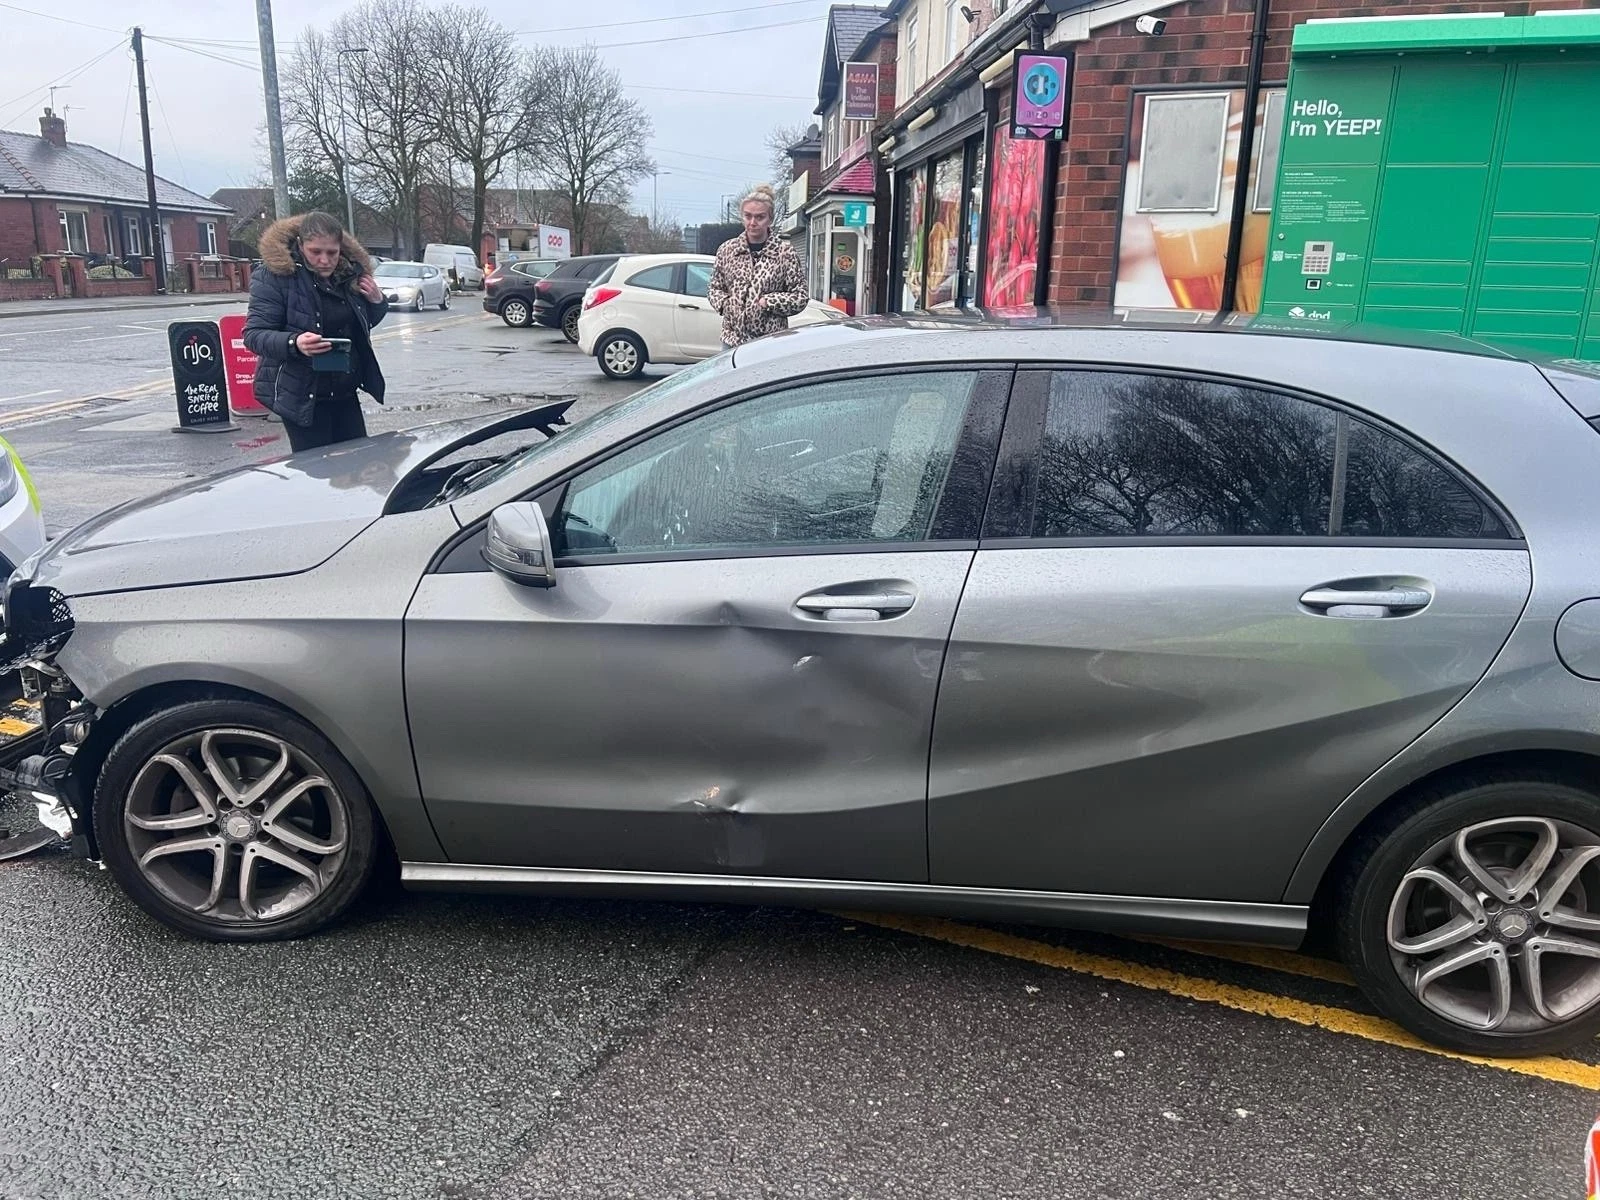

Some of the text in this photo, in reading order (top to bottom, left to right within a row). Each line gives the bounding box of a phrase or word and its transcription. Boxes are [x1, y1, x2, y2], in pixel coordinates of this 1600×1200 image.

[1292, 100, 1343, 118] Hello,
[1290, 119, 1382, 136] I'm YEEP!
[183, 338, 211, 365] rijo
